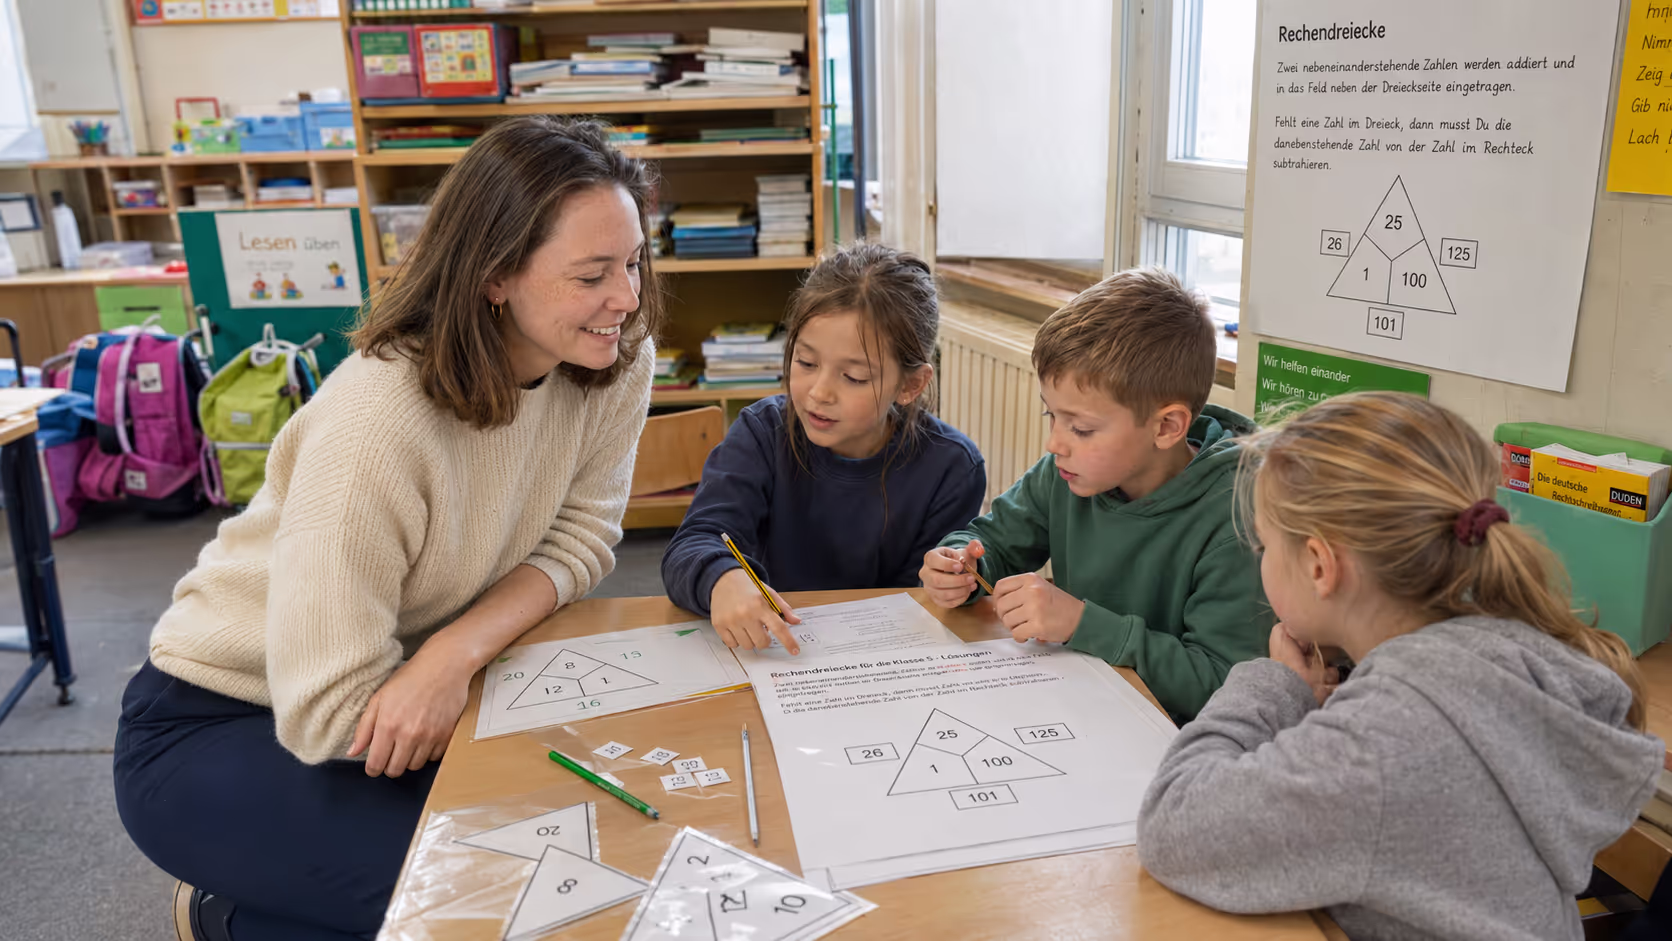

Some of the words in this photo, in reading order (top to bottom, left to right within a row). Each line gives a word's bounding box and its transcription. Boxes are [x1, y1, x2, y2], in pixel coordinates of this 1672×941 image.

[1279, 20, 1386, 43] Rechendreiecke
[1277, 62, 1298, 73] Zwei
[1303, 59, 1420, 73] nebeneinanderstehende
[1423, 58, 1458, 71] Zahlen
[1464, 58, 1501, 70] werden
[1506, 55, 1548, 70] addiert
[1554, 55, 1576, 69] und
[1636, 66, 1663, 86] Zeig
[1276, 83, 1285, 94] in
[1288, 82, 1304, 94] das
[1308, 81, 1328, 94] Feld
[1330, 81, 1357, 93] neben
[1362, 80, 1378, 93] der
[1382, 80, 1442, 94] Dreieckseite
[1446, 80, 1516, 96] eingetragen.
[1632, 98, 1650, 112] Gib
[1275, 116, 1296, 128] Fehlt
[1300, 118, 1320, 128] eine
[1324, 116, 1344, 128] Zahl
[1348, 118, 1360, 128] im
[1366, 116, 1404, 132] Dreieck,
[1409, 118, 1434, 130] dann
[1440, 118, 1470, 130] musst
[1476, 118, 1490, 130] Du
[1495, 119, 1512, 130] die
[1628, 128, 1660, 144] Lach
[1274, 137, 1354, 150] danebenstehende
[1359, 139, 1380, 151] Zahl
[1386, 142, 1402, 152] von
[1408, 140, 1426, 152] der
[1432, 140, 1456, 152] Zahl
[1462, 142, 1476, 154] im
[1484, 141, 1534, 154] Rechteck
[1273, 157, 1332, 170] subtrahieren.
[1384, 214, 1403, 230] 25
[239, 231, 298, 250] Lesen
[304, 236, 341, 251] üben
[1327, 236, 1342, 250] 26
[1448, 246, 1471, 262] 125
[1363, 268, 1369, 281] 1
[1402, 272, 1427, 288] 100
[1374, 316, 1396, 332] 101
[1264, 354, 1278, 368] Wir
[1281, 358, 1308, 374] helfen
[1311, 366, 1351, 383] einander
[1262, 377, 1277, 391] Wir
[1280, 382, 1304, 398] hören
[1308, 391, 1319, 401] zu
[1538, 472, 1550, 484] Die
[1552, 476, 1588, 493] deutsche
[1611, 490, 1642, 505] DUDEN
[565, 662, 576, 670] 8
[770, 665, 858, 679] Rechendreiecke
[502, 671, 525, 682] 20
[545, 686, 564, 694] 12
[577, 700, 601, 710] 16
[936, 729, 958, 740] 25
[1029, 728, 1059, 740] 125
[862, 748, 884, 759] 26
[930, 764, 939, 774] 1
[982, 756, 1013, 768] 100
[968, 790, 998, 803] 101
[536, 826, 560, 836] 20
[686, 856, 710, 865] 2
[556, 878, 578, 894] 8
[774, 894, 806, 914] 10
